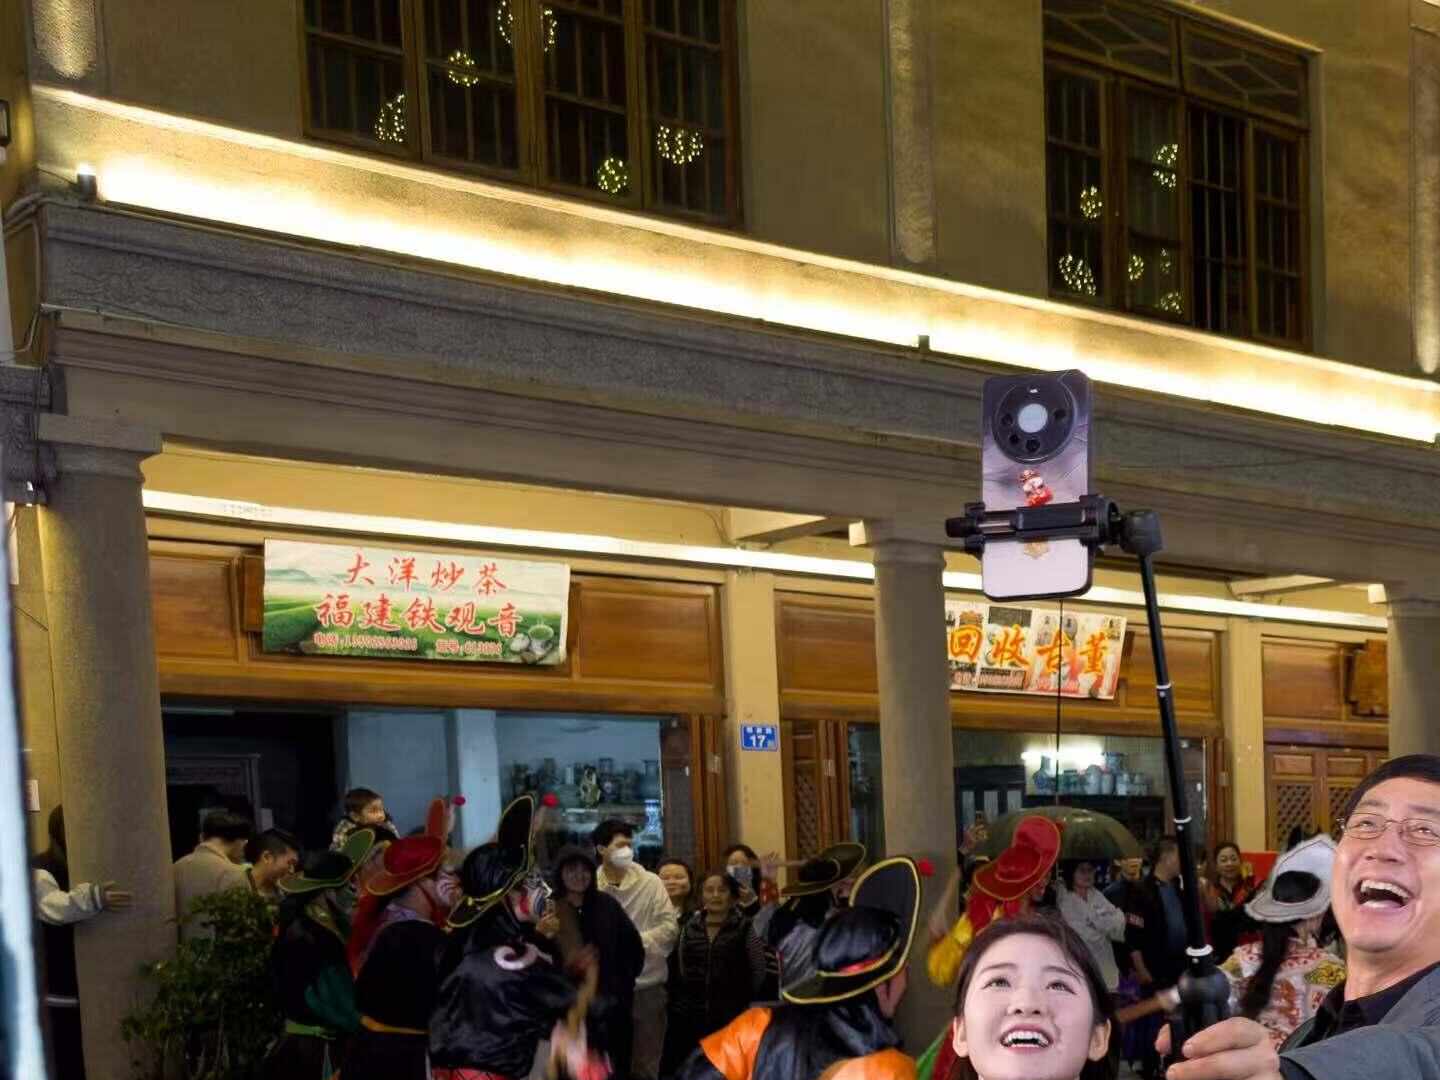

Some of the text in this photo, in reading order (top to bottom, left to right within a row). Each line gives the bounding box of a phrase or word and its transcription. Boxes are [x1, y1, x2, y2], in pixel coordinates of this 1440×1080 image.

[344, 551, 507, 597] 大洋炒茶
[314, 592, 523, 638] 福建铁观音
[950, 624, 1108, 673] 回收古董
